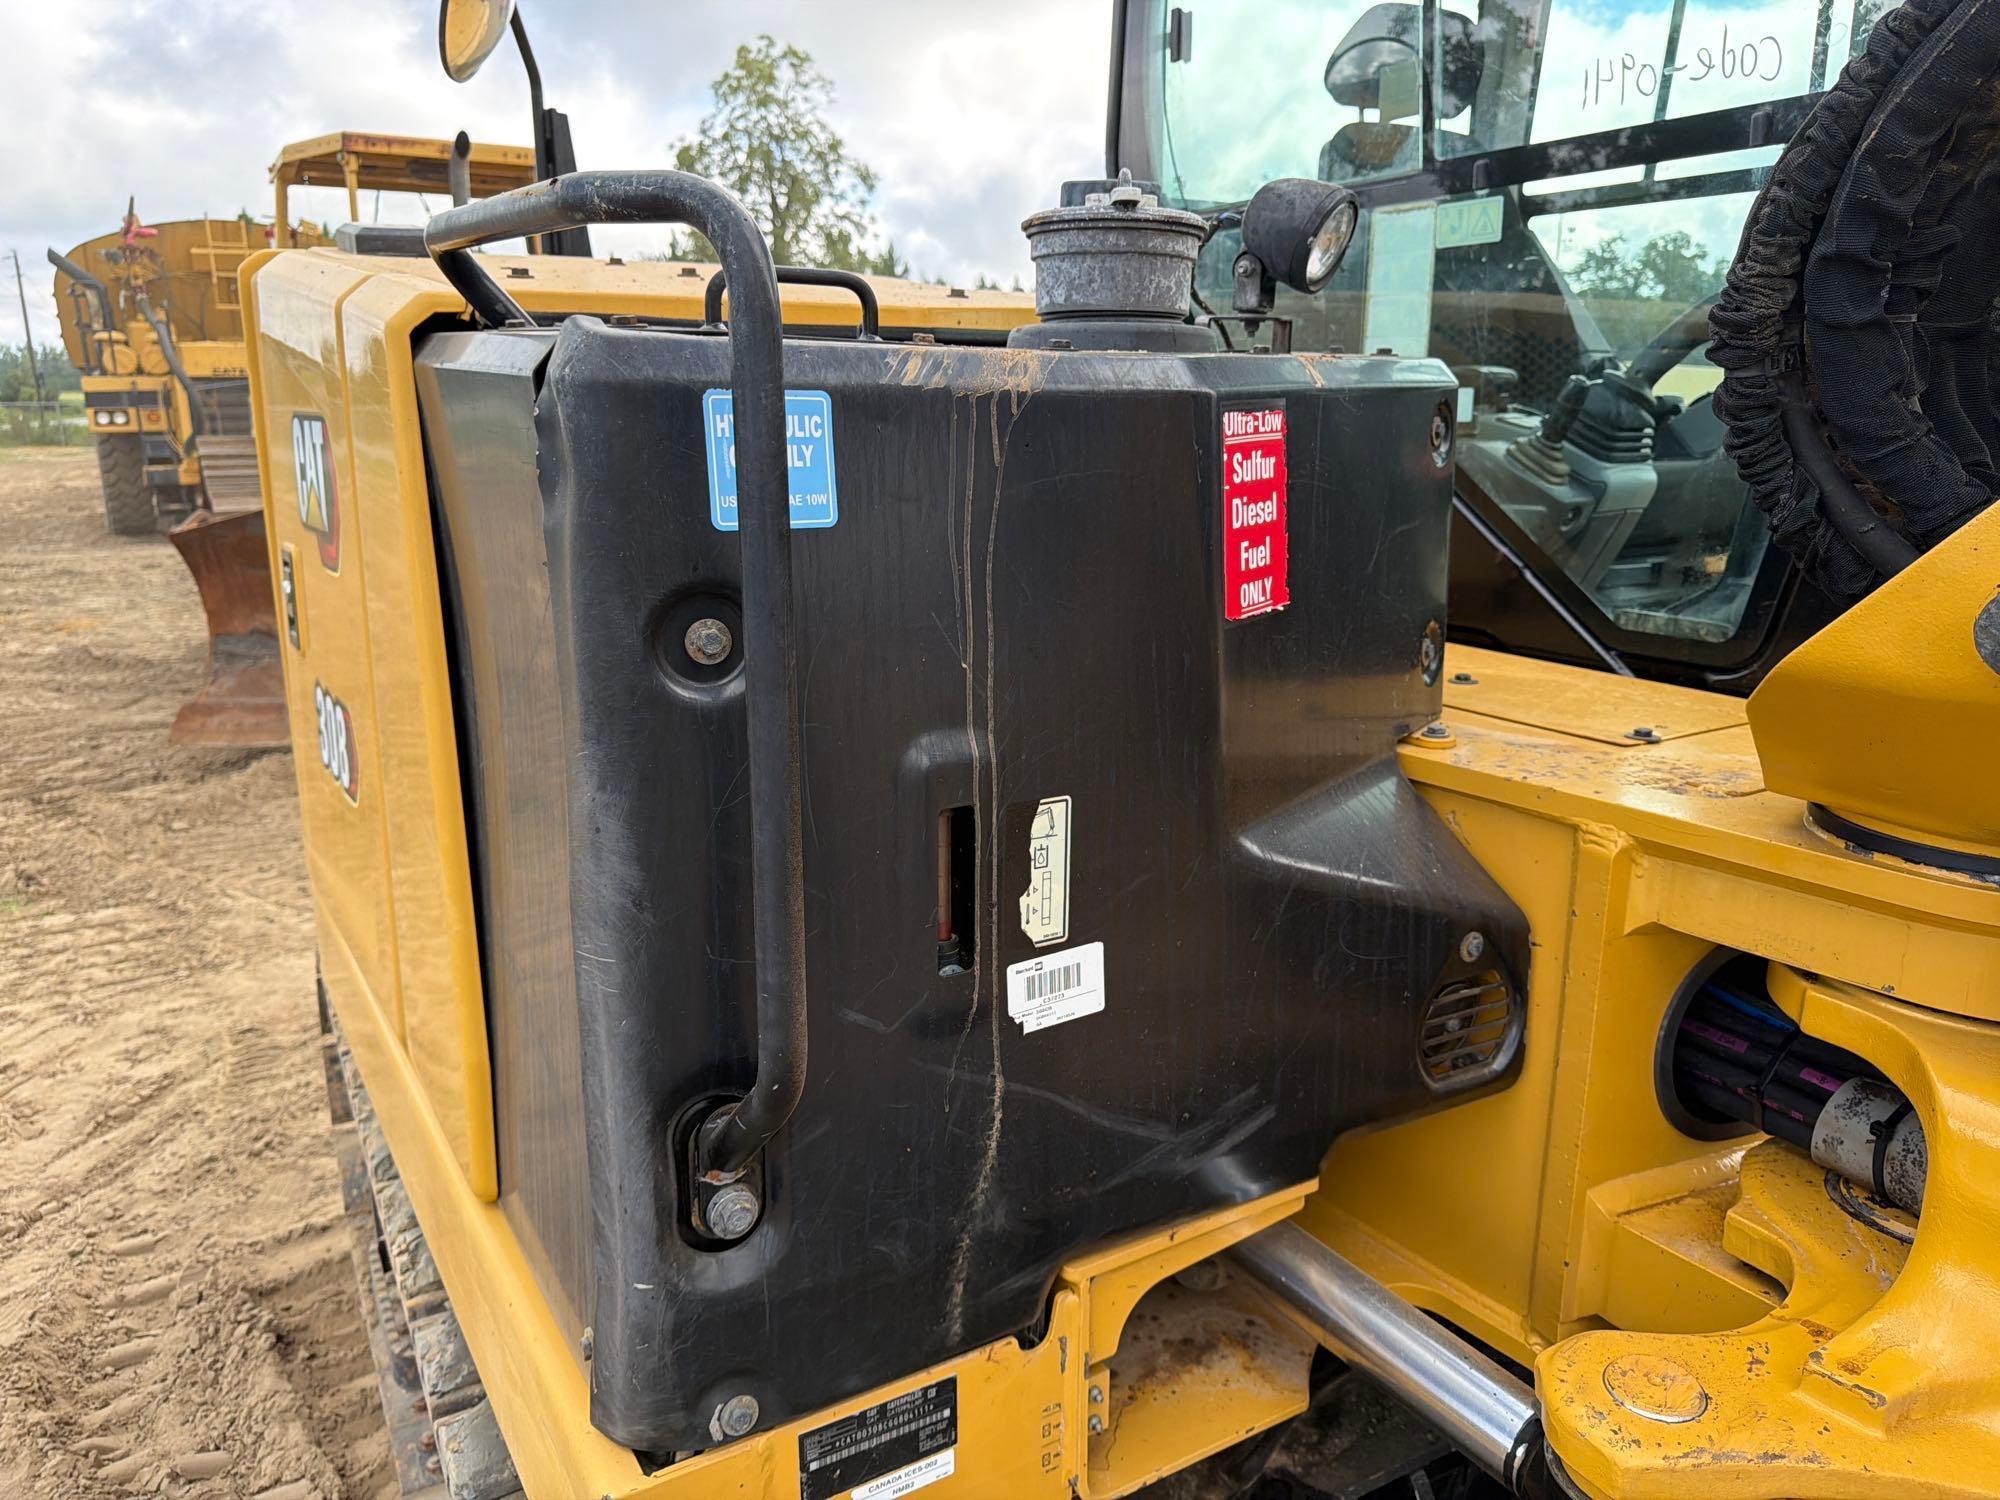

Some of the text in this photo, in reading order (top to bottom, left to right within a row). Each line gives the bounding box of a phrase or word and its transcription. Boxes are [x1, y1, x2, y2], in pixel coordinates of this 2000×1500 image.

[715, 414, 823, 438] HULIC
[1224, 411, 1282, 436] Ultra-Low
[292, 417, 328, 532] CAT
[1232, 450, 1275, 484] Sulfur
[806, 493, 827, 505] 10W
[1232, 492, 1277, 529] Diesel
[1240, 536, 1270, 571] Fuel
[1240, 576, 1273, 607] ONLY
[868, 1475, 903, 1493] CANADA
